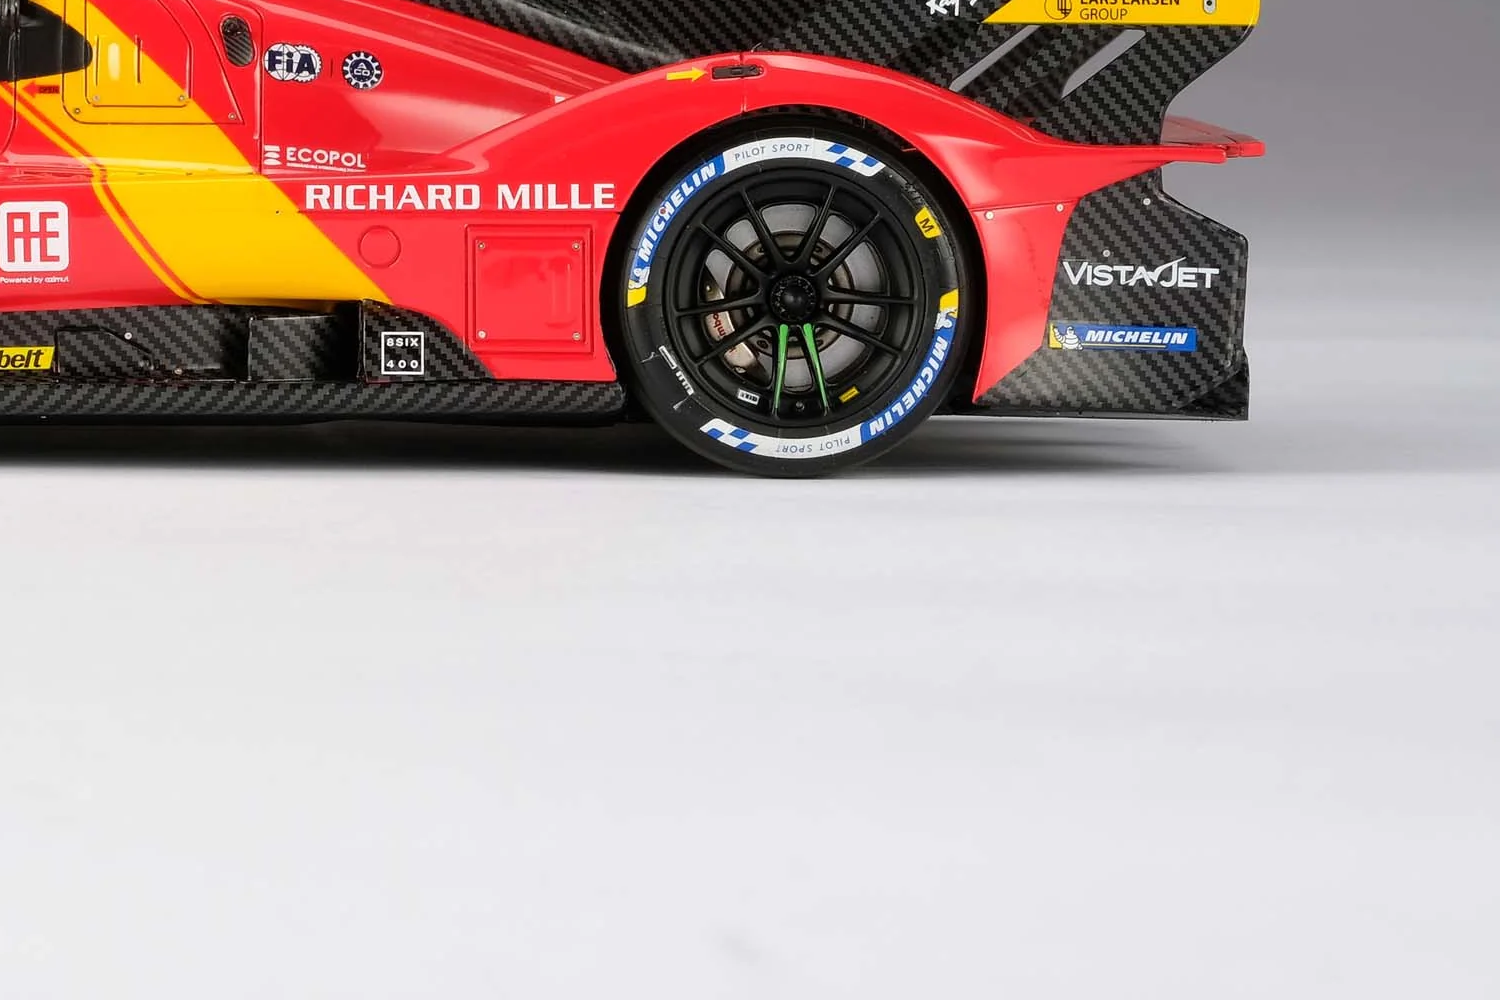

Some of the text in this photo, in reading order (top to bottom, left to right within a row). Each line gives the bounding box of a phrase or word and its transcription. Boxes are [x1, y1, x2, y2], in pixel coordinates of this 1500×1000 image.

[1079, 7, 1128, 21] GROUP
[286, 147, 367, 168] ECOPOL
[734, 143, 811, 162] PILOT SPORT
[305, 183, 615, 210] RICHARD MILLE
[638, 162, 716, 263] MICHELIN
[919, 217, 935, 233] M
[0, 276, 33, 284] Powered
[34, 276, 44, 285] by
[1062, 256, 1220, 289] VISTAJET
[386, 337, 419, 347] 8SIX
[1085, 330, 1189, 345] MICHELIN
[869, 336, 949, 437] MICHELIN
[776, 436, 850, 453] PILOT SPORT
